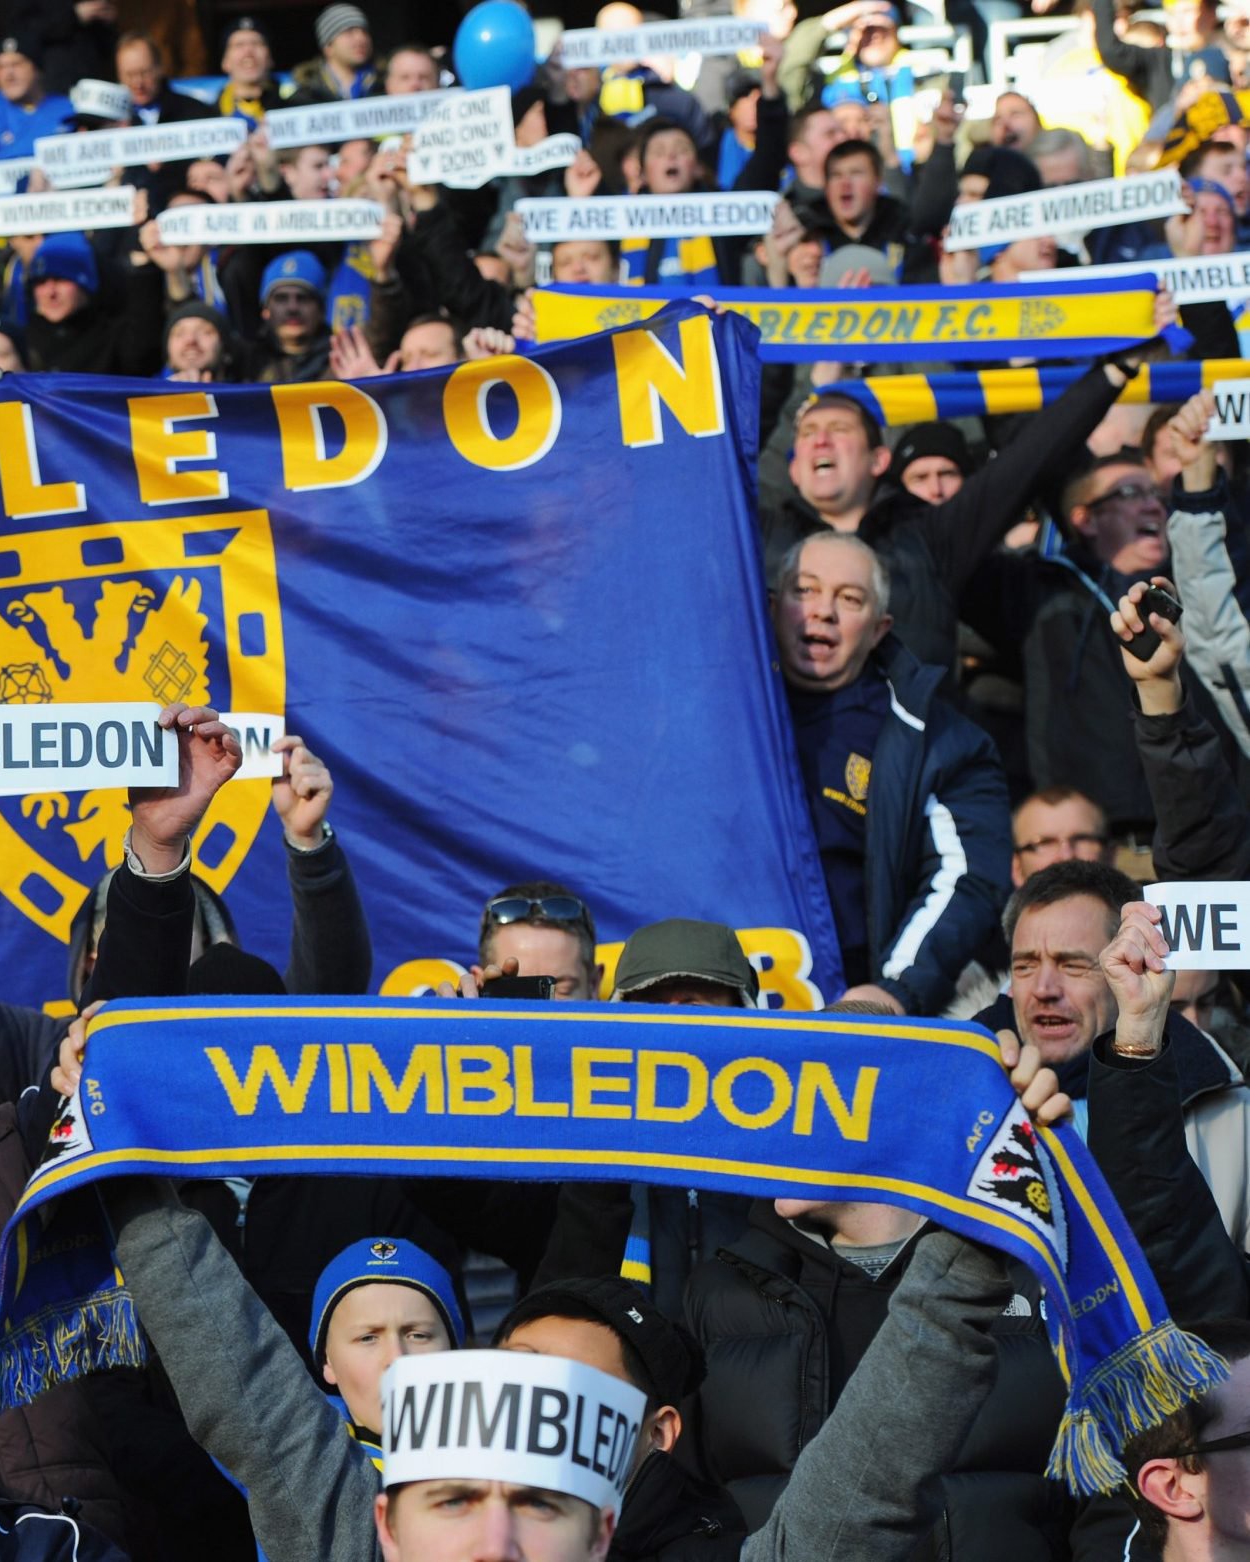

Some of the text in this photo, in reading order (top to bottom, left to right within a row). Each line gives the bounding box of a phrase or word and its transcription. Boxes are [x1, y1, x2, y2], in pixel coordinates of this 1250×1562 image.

[308, 113, 343, 133] ARE
[419, 128, 455, 148] AND
[76, 140, 112, 161] ARE
[121, 127, 242, 154] WIMBLEDON
[0, 197, 129, 224] WIMBLEDON
[524, 202, 775, 232] WE ARE WIMBLEDON
[948, 179, 1183, 238] WE ARE WIMBLEDON
[1164, 263, 1250, 292] IMBLE
[1156, 903, 1241, 952] WE
[85, 1078, 107, 1117] AFC
[203, 1043, 881, 1143] WIMBLEDON
[965, 1109, 996, 1154] AFC
